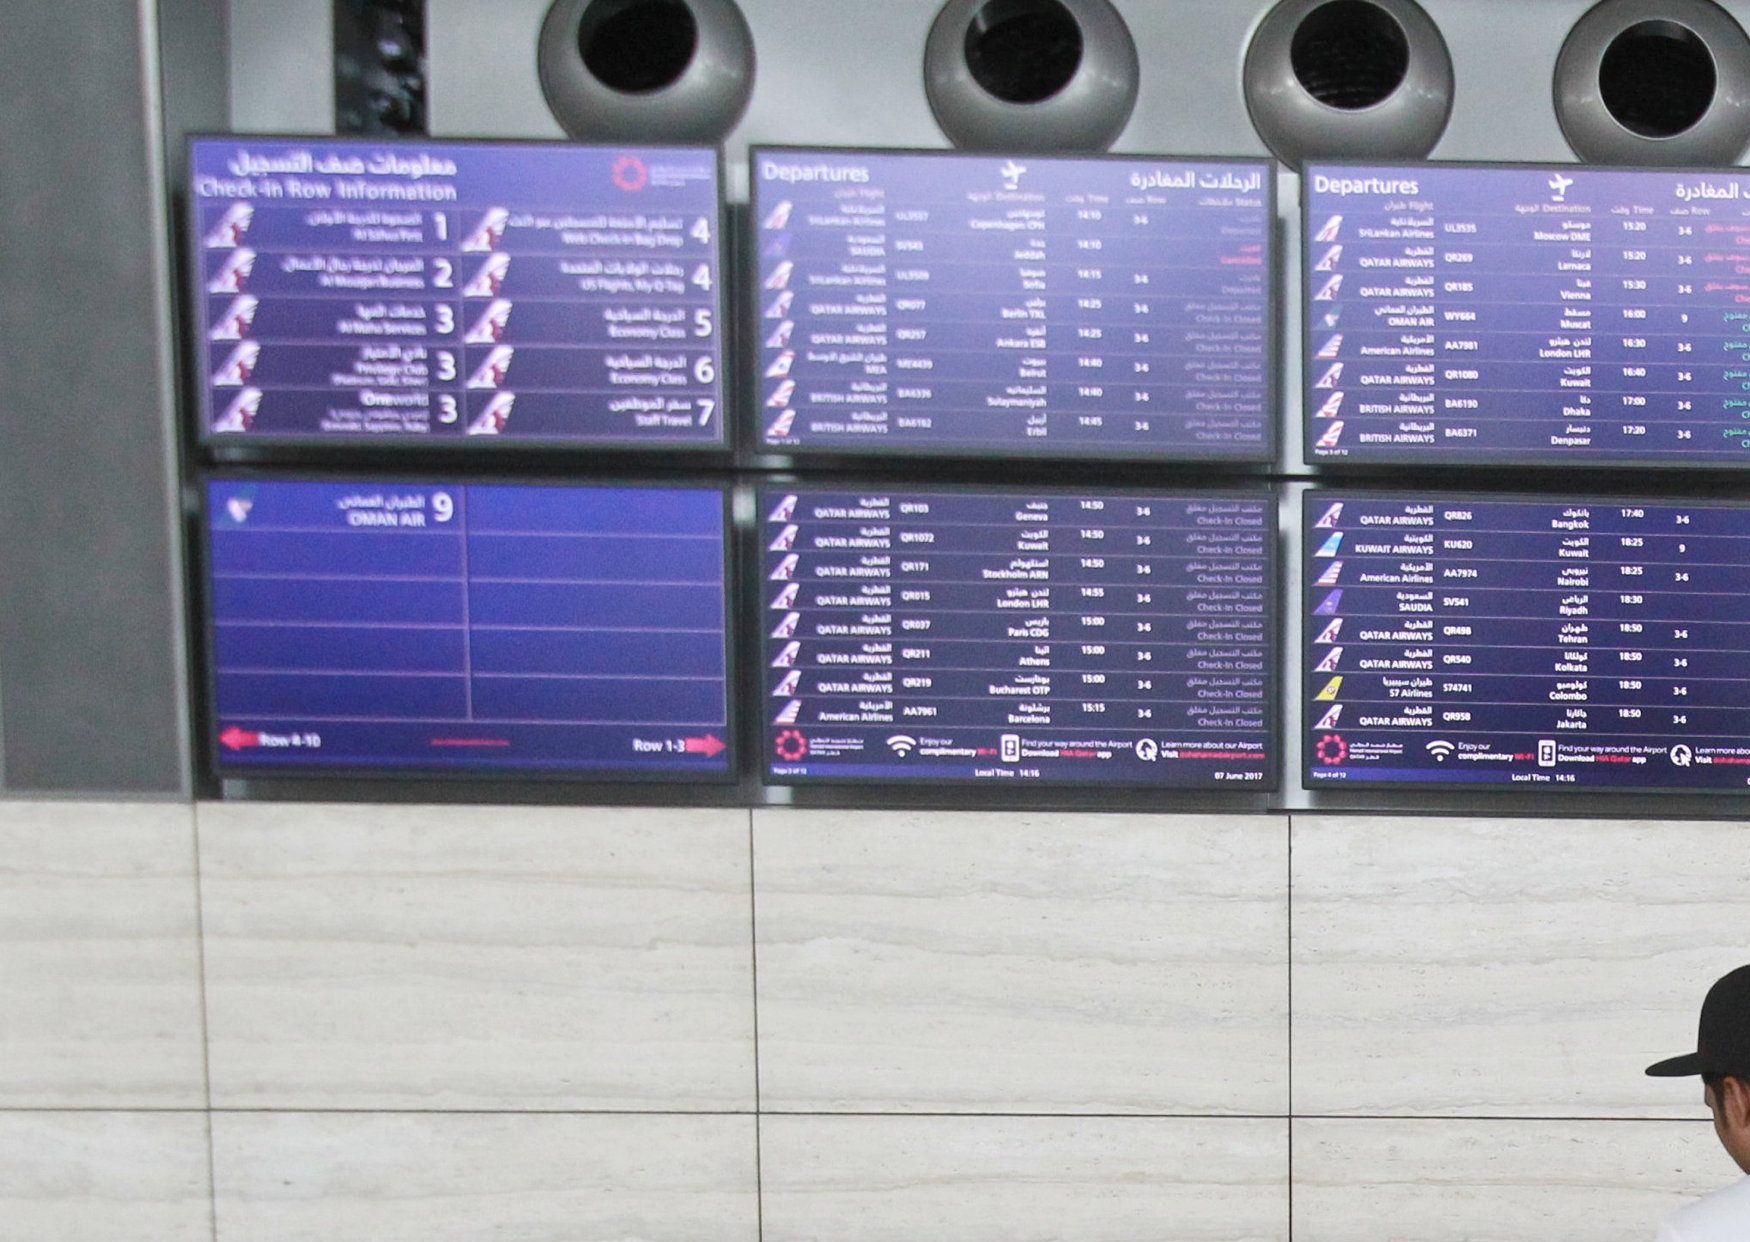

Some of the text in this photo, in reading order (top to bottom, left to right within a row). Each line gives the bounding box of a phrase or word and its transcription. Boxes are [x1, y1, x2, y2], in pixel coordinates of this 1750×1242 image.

[369, 155, 457, 178] معلومات
[761, 161, 870, 183] Departures
[1128, 169, 1261, 192] الرحلات المغادرة
[1313, 173, 1419, 196] Departures
[197, 177, 457, 201] Check-in Row Information
[1675, 181, 1739, 202] المغادرة
[432, 213, 447, 240] 1
[689, 216, 711, 244] 4
[433, 260, 453, 287] 2
[691, 263, 713, 291] 4
[434, 306, 454, 334] 3
[694, 308, 712, 336] 5
[437, 351, 456, 380] 3
[693, 355, 715, 383] 6
[438, 396, 458, 423] 3
[696, 398, 715, 426] 7
[1562, 406, 1591, 416] Dhaka
[1550, 435, 1591, 446] Denpasar
[431, 491, 453, 522] 9
[1621, 508, 1645, 518] 17:40
[347, 510, 426, 527] OMAN AIR
[1551, 519, 1589, 531] Bangkok
[1354, 544, 1434, 555] KUWAIT AIRWAYS
[1620, 537, 1644, 547] 18:25
[1558, 548, 1589, 558] Kuwait
[1359, 573, 1434, 584] American Airlines
[1556, 576, 1589, 586] Nairobi
[996, 598, 1031, 608] London
[1398, 602, 1433, 612] SAUDIA
[1559, 605, 1588, 616] Riyadh
[1557, 634, 1588, 644] Tehran
[1018, 656, 1050, 666] Athens
[1554, 662, 1588, 672] Kolkata
[1548, 690, 1588, 701] Colombo
[1007, 713, 1051, 724] Barcelona
[1556, 719, 1587, 729] Jakarta
[632, 738, 688, 753] Row 1-3
